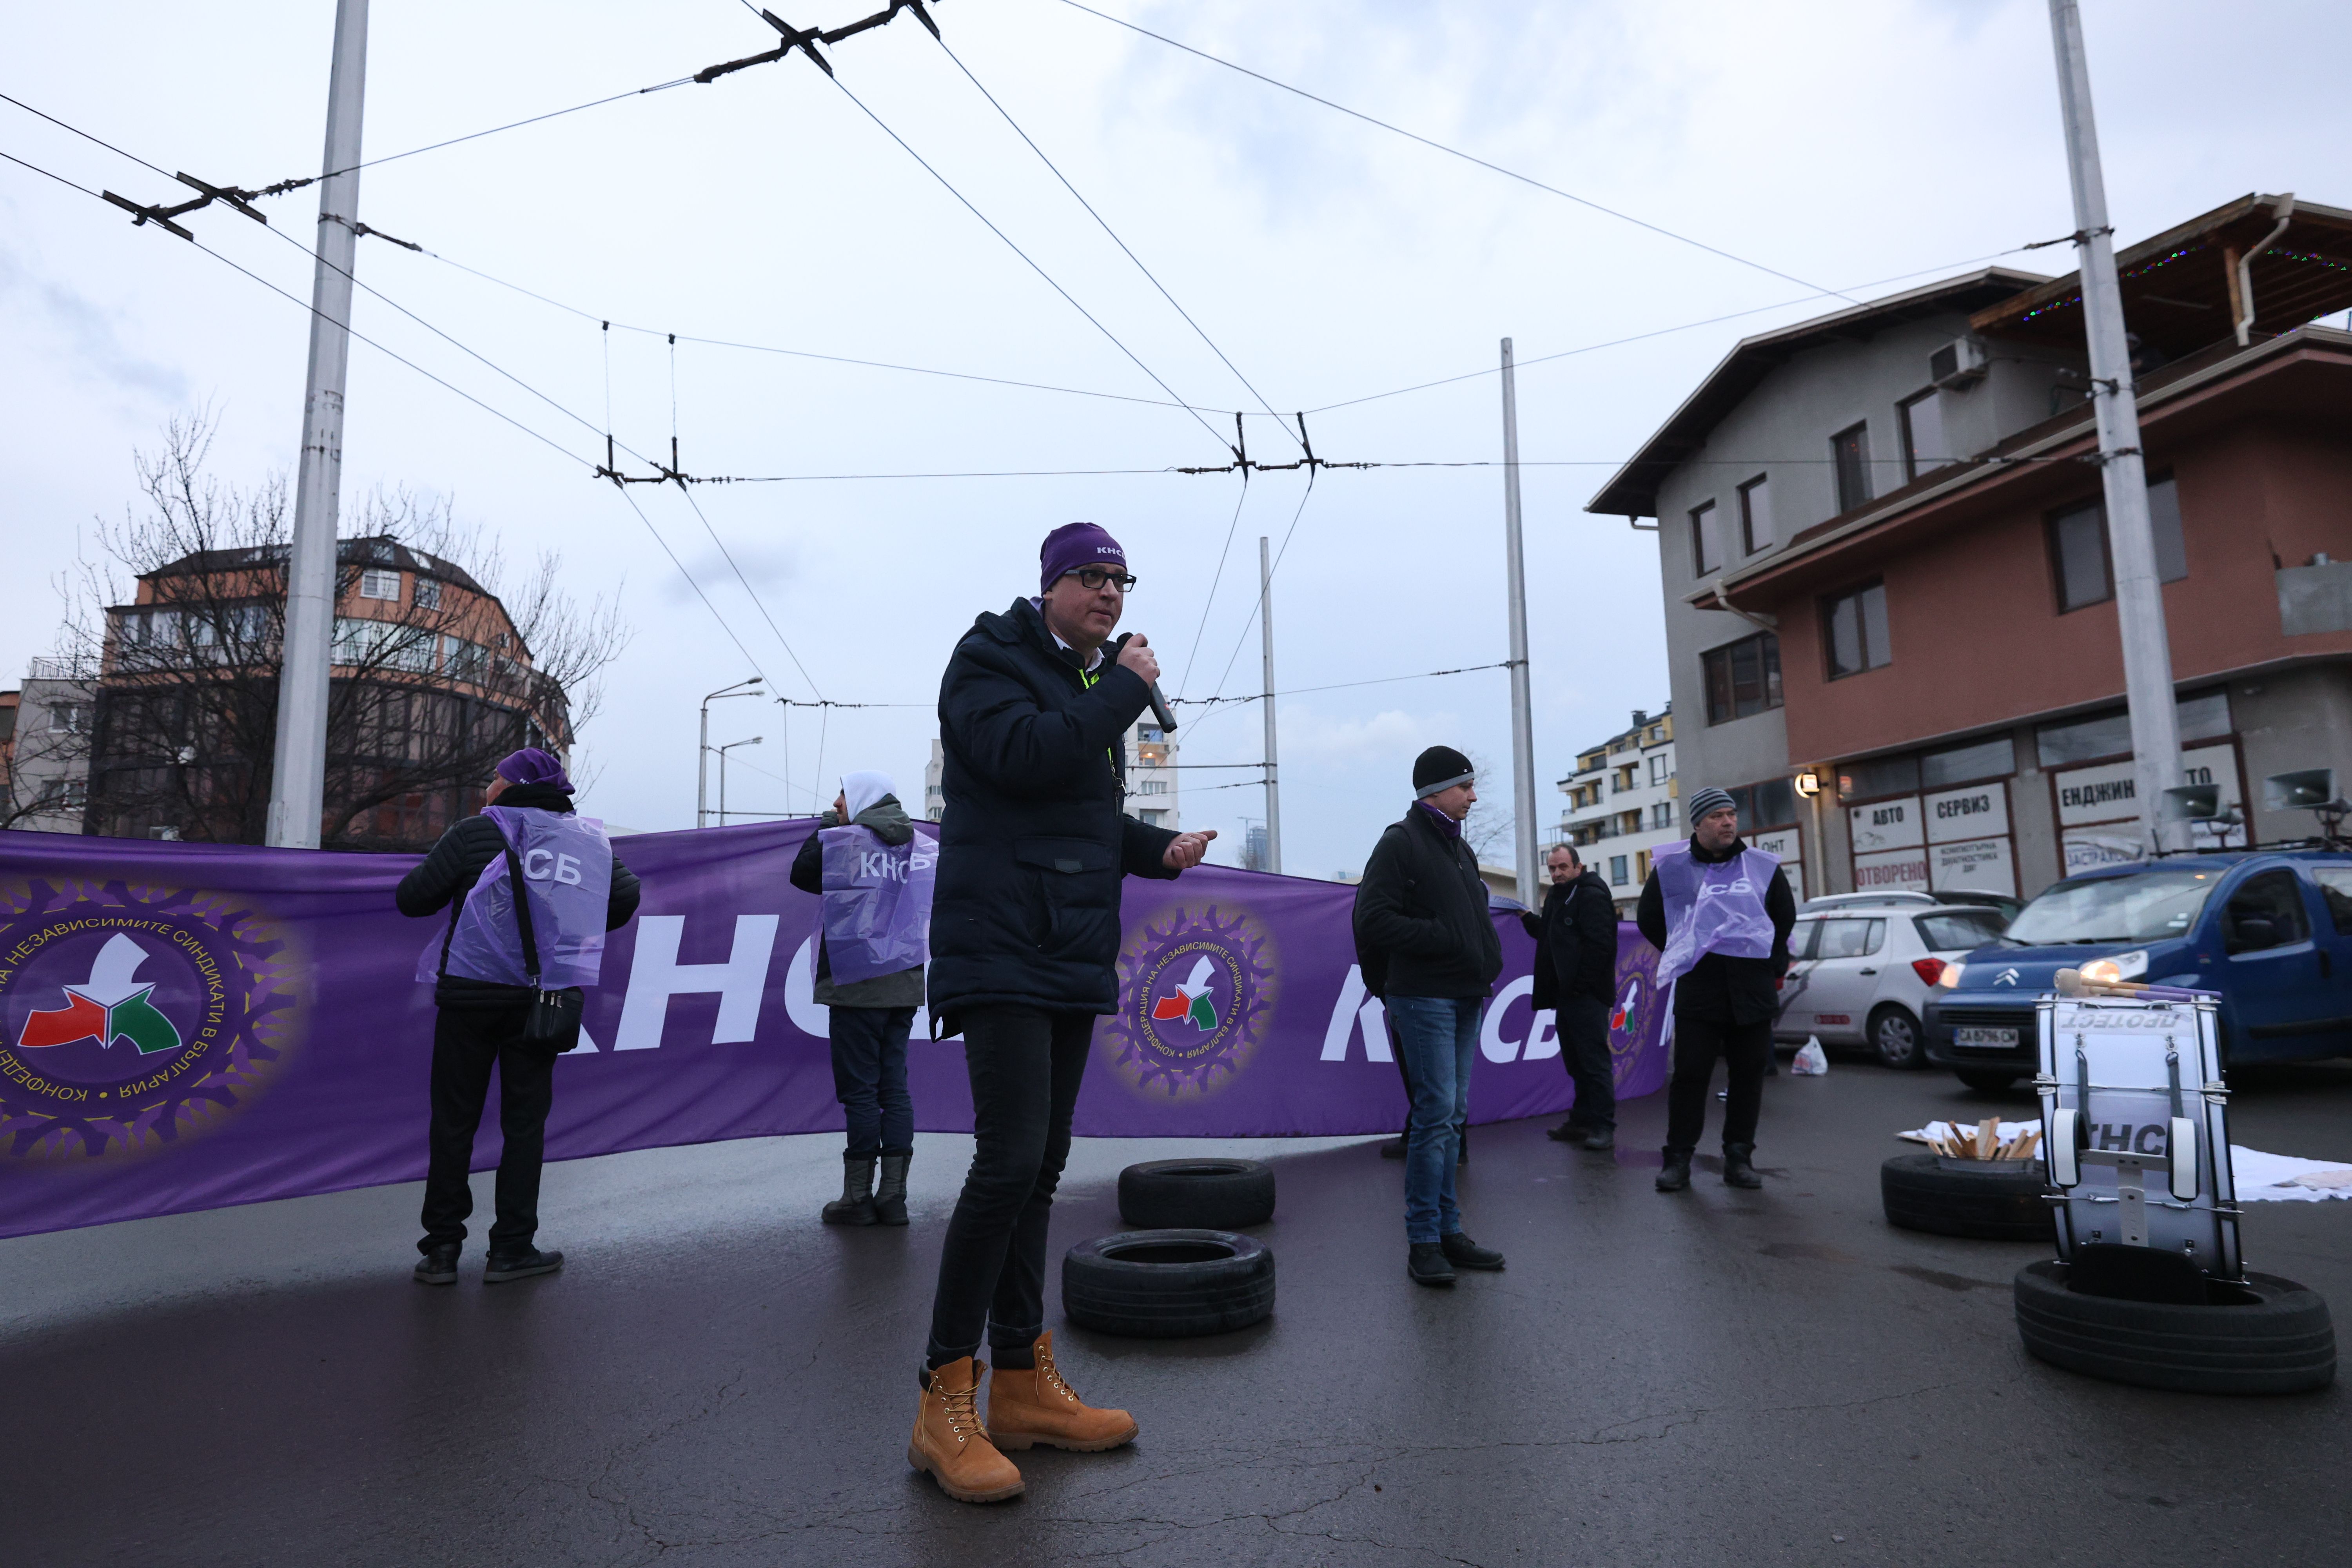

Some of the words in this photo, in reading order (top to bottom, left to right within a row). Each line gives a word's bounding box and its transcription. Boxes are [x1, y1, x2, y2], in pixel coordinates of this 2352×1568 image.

[2062, 779, 2135, 807] ЕНДЖИН
[2185, 767, 2212, 784] ТО
[1873, 806, 1904, 826] АВТО
[1937, 795, 1990, 818] СЕРВИЗ
[520, 849, 582, 886] СБ
[1856, 860, 1927, 887] ОТВОРЕНО
[5, 918, 174, 966] НЕЗАВИСИМИТЕ
[1157, 941, 1229, 970] НЕЗАВИСИМИТЕ
[172, 930, 225, 1023] СИНДИКАТИ
[1146, 970, 1158, 985] НА
[1227, 956, 1243, 1016] СИНДИКАТИ
[201, 1028, 217, 1038] В
[1139, 986, 1175, 1058] КОНФЕДЕРАЦИЯ
[2061, 1013, 2180, 1029] ПРОТЕСТ
[1186, 1025, 1230, 1059] БЪЛГАРИЯ
[0, 1041, 88, 1101] КОНФЕДЕ
[119, 1041, 209, 1099] БЪЛГАРИЯ
[2090, 1123, 2166, 1156] НС
